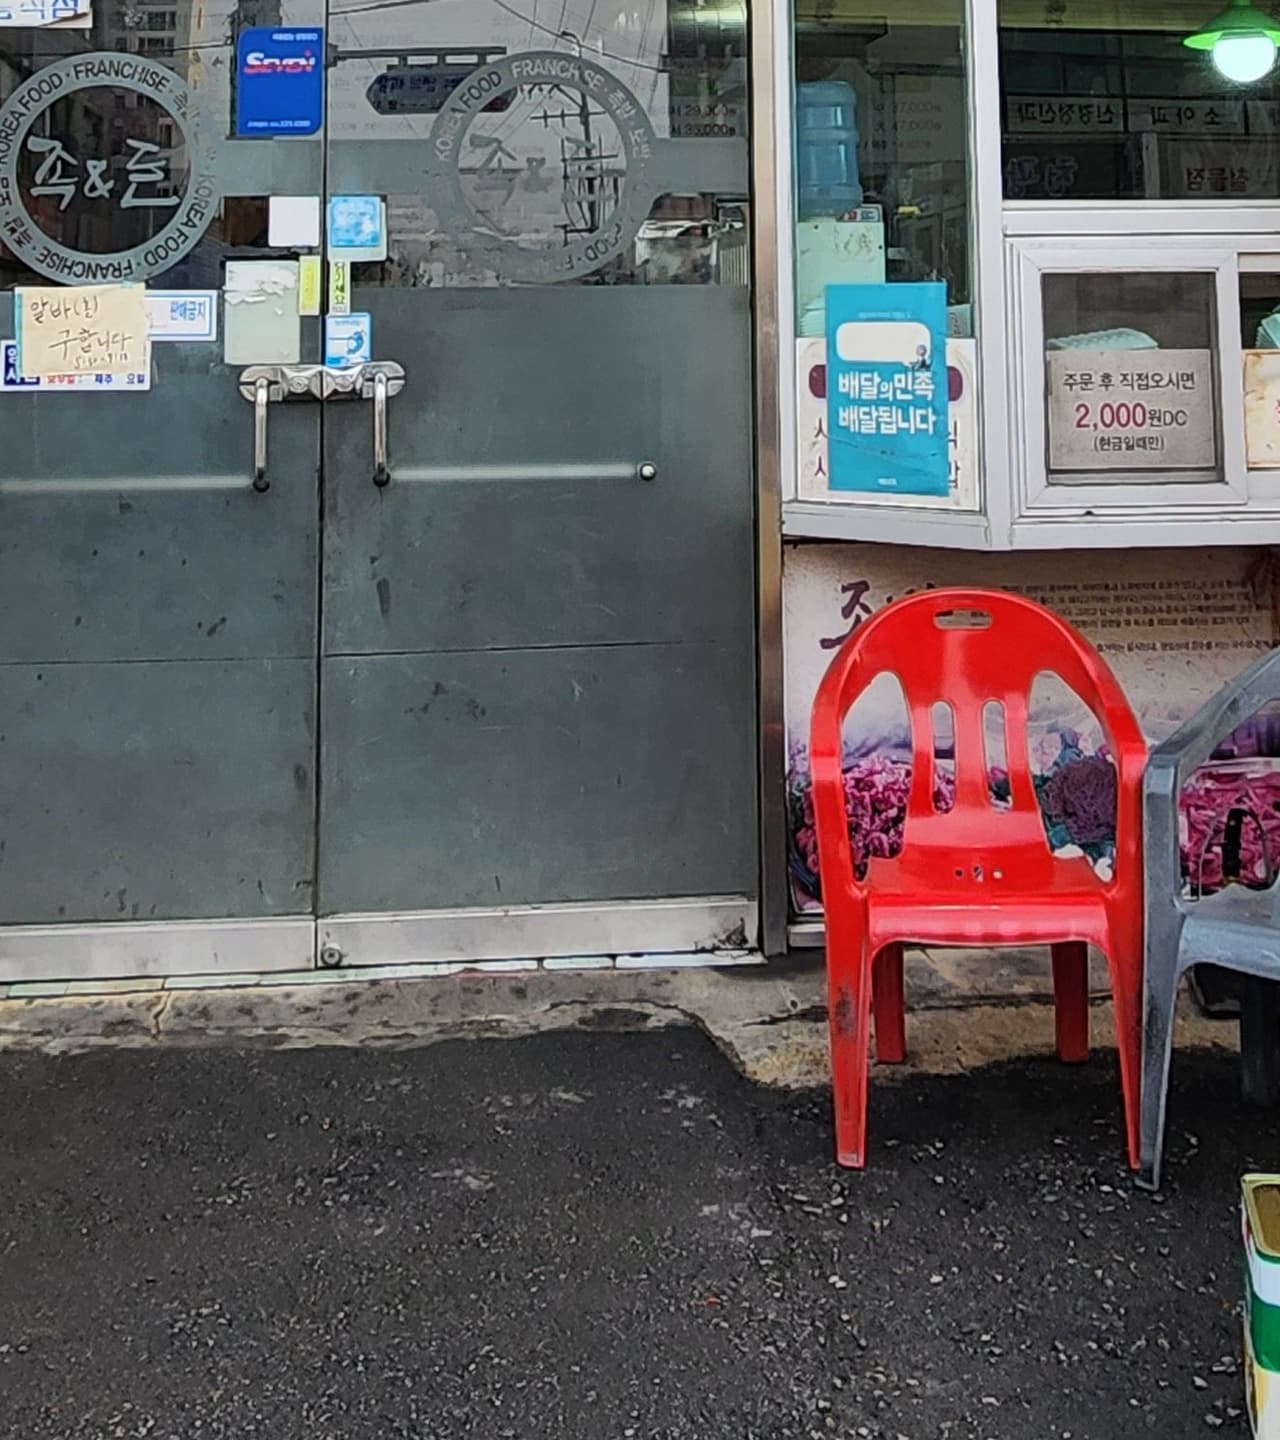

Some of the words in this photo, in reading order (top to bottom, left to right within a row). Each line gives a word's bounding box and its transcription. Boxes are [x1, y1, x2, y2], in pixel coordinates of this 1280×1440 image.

[19, 72, 64, 112] FOOD
[74, 60, 170, 94] FRANCHISE
[34, 246, 134, 280] FRANCHISE
[48, 327, 133, 360] 구합니다
[838, 371, 935, 402] 배달의민족
[1063, 372, 1095, 392] 주문
[1098, 372, 1115, 391] 후
[1121, 371, 1196, 392] 직접오시면
[838, 405, 936, 436] 배달됩니다
[1075, 402, 1188, 430] 2,000원DC
